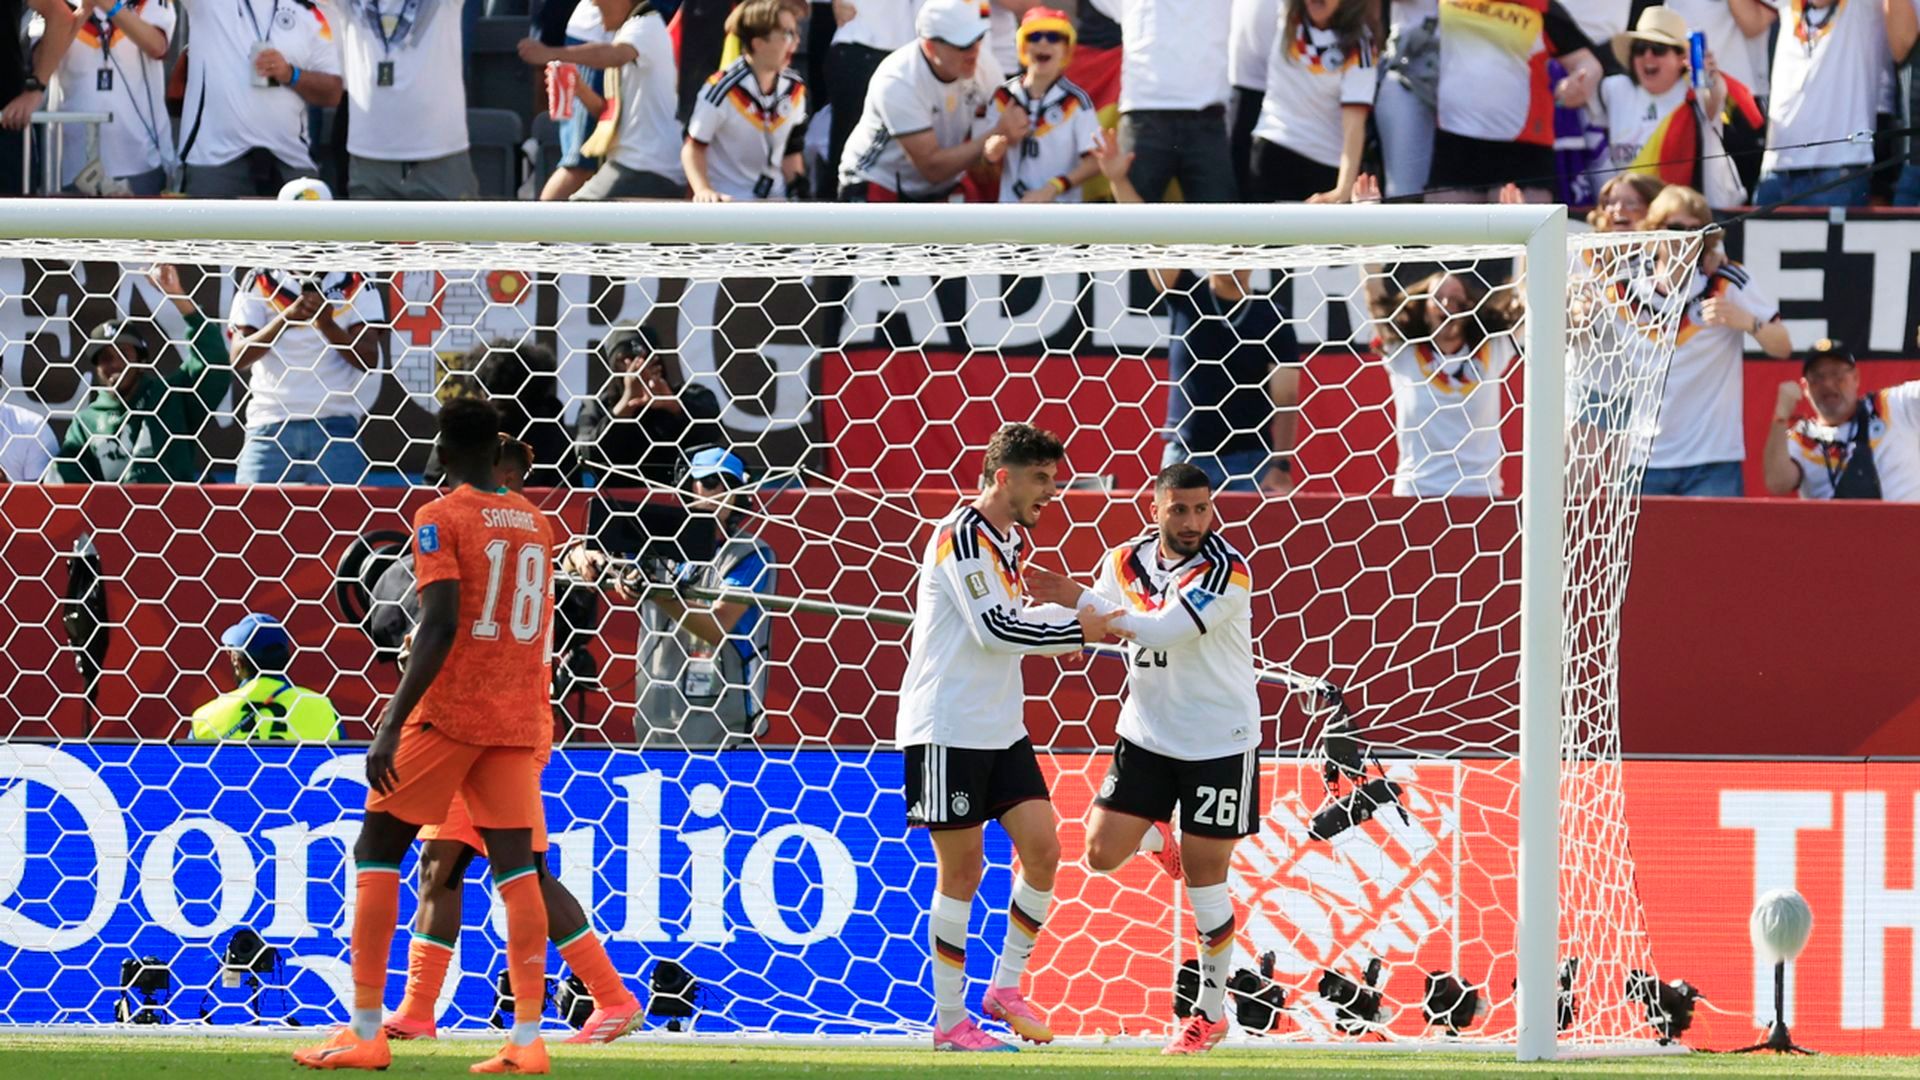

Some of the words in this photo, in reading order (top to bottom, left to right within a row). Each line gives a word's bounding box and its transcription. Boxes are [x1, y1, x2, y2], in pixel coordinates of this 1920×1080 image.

[838, 262, 1376, 346] ADLR
[481, 508, 538, 533] SANGARE
[471, 539, 545, 644] 18
[1193, 785, 1238, 827] 26
[1288, 868, 1456, 1040] DPOT
[1719, 789, 1920, 1030] TH
